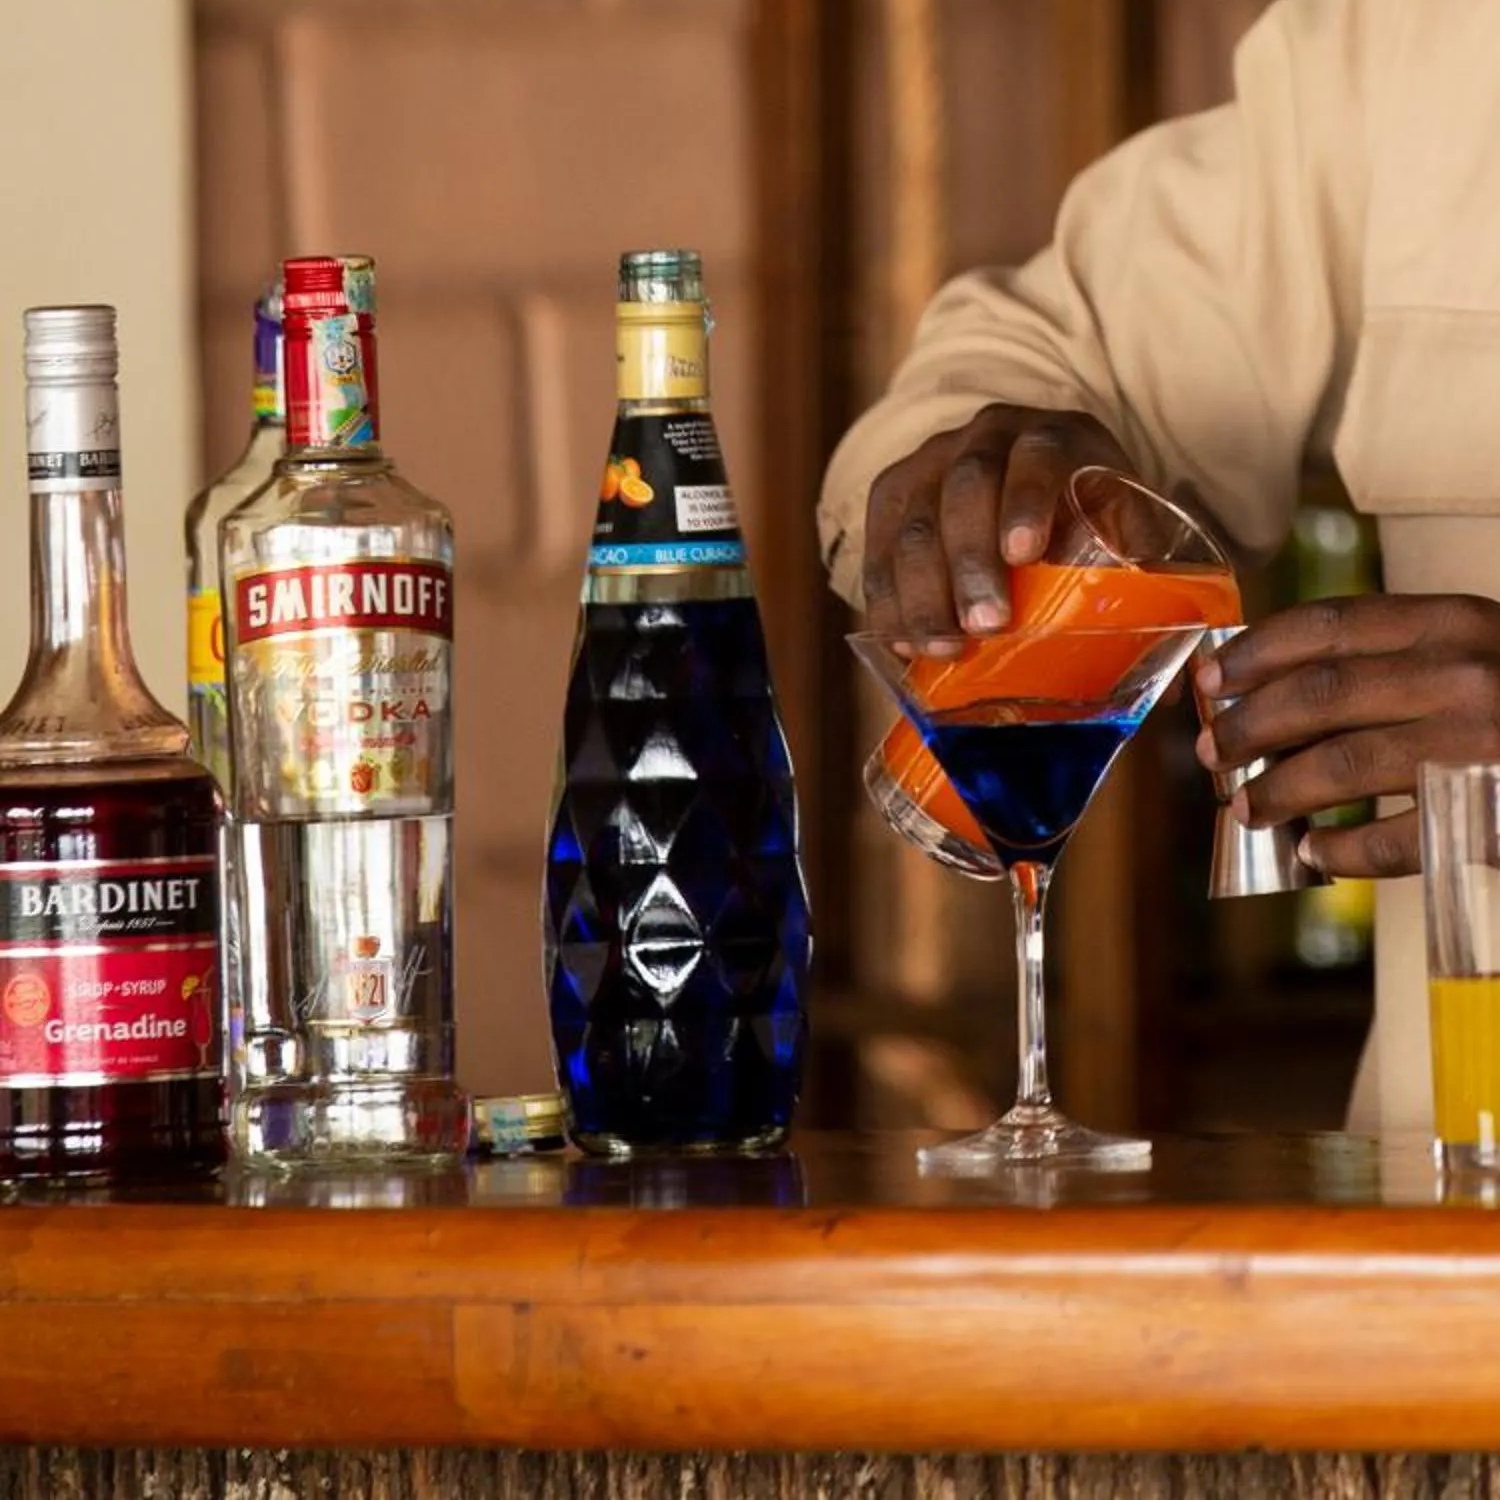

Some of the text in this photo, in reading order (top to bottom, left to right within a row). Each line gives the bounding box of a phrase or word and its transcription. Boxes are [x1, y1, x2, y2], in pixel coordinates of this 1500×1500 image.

[247, 572, 447, 628] SMIRNOFF
[21, 879, 199, 917] BARDINET
[44, 1013, 187, 1044] Grenadine
